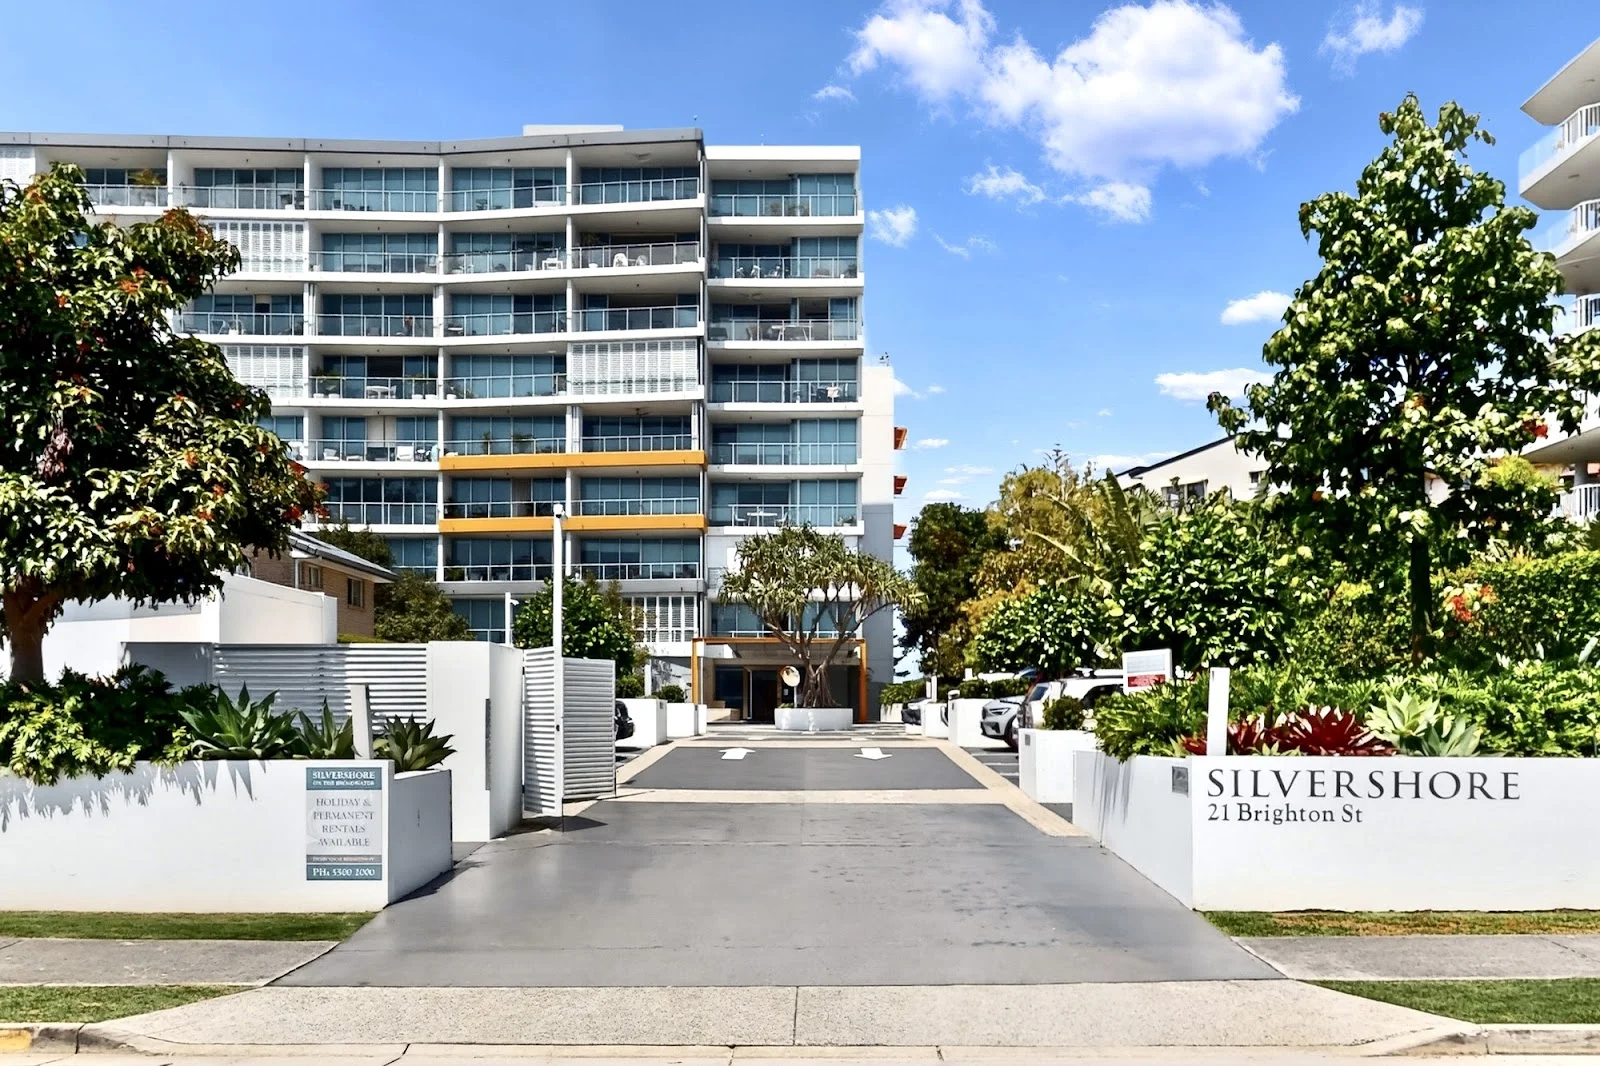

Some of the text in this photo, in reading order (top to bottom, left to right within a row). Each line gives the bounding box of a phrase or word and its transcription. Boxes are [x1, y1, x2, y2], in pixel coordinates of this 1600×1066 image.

[312, 771, 376, 779] SILVERSHORE
[1207, 768, 1521, 800] SILVERSHORE
[316, 798, 372, 807] HOLIDAY &
[313, 811, 375, 820] PERMANENT
[1207, 803, 1364, 825] 21 Brighton St
[322, 825, 366, 833] RENTALS
[319, 838, 370, 847] AVAILABLE
